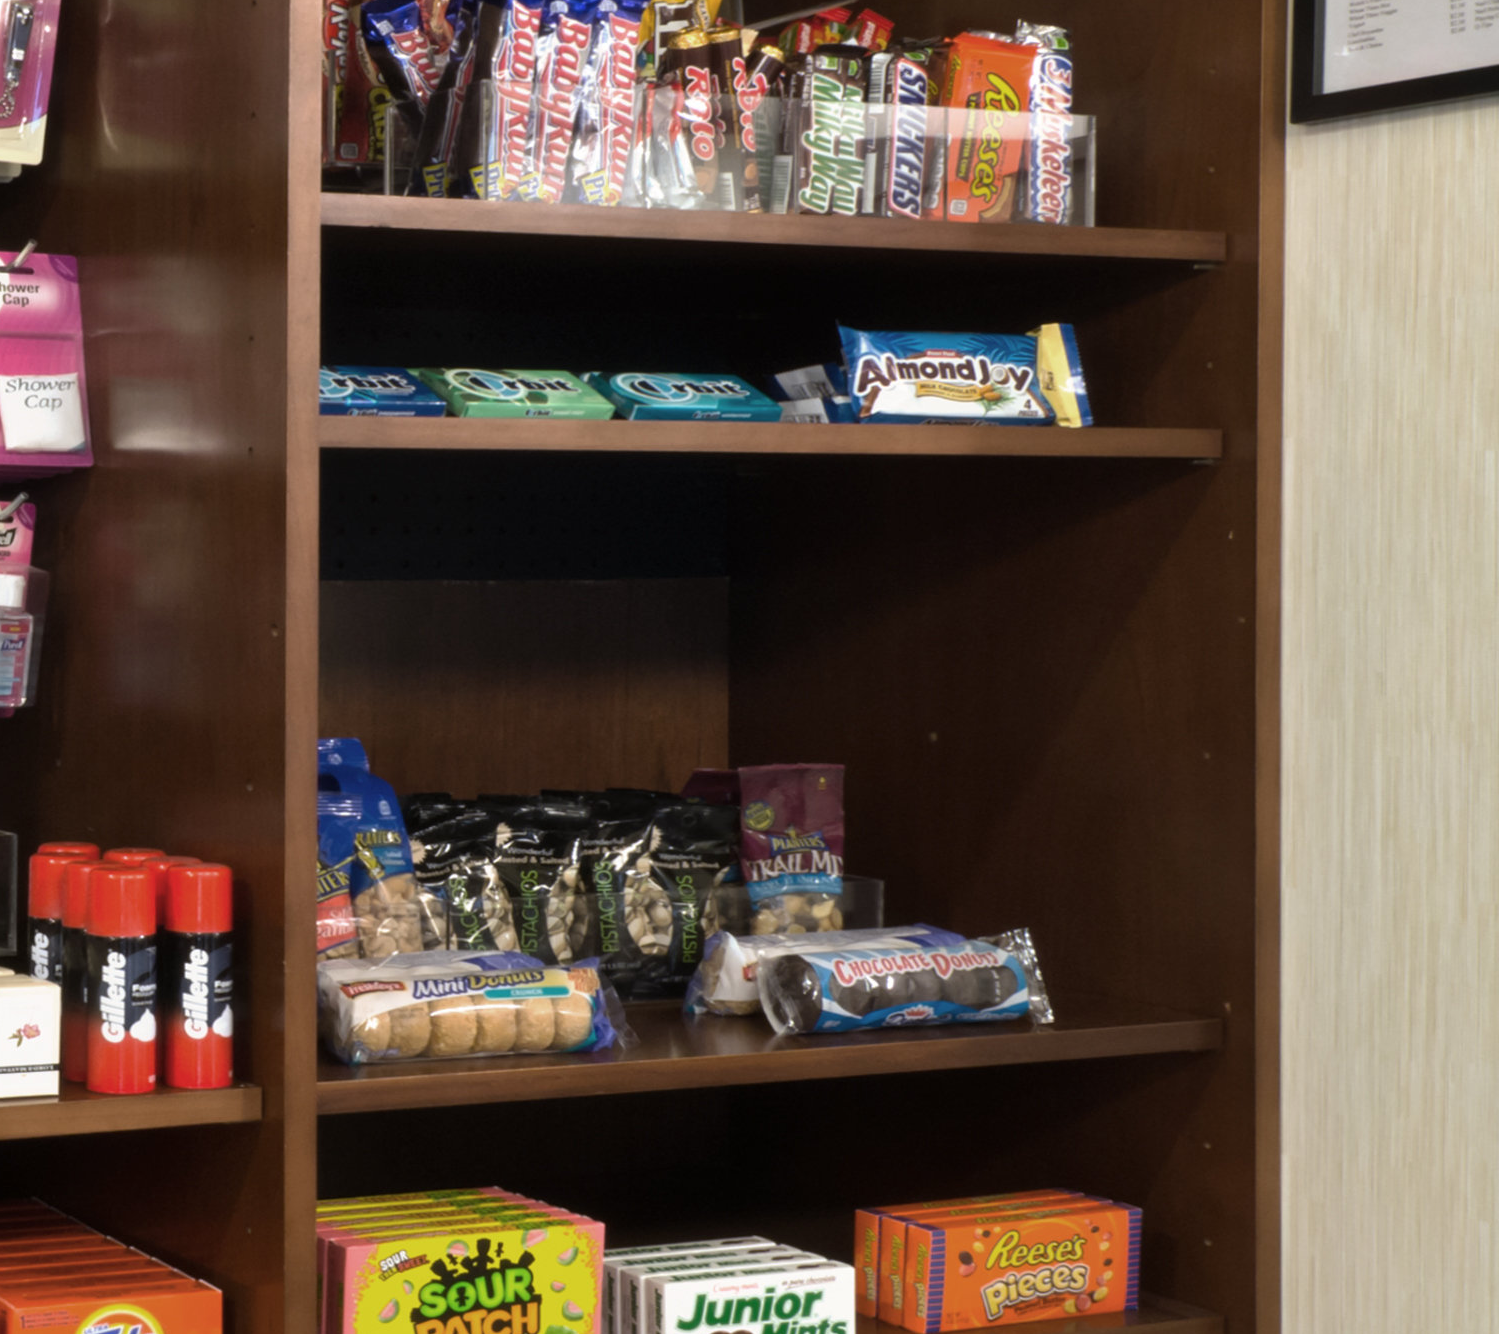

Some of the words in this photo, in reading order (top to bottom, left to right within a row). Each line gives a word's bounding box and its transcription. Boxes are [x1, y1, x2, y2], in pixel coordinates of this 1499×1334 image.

[891, 60, 928, 218] SNICKERS
[1, 292, 31, 308] Cap
[4, 377, 77, 396] Shower
[856, 356, 977, 395] Almond
[23, 393, 64, 413] Cap
[412, 979, 466, 1000] Mini
[468, 970, 545, 992] Donuts
[833, 951, 931, 987] CHOCOLATE
[932, 949, 1000, 980] DONUTS
[99, 950, 127, 1044] Gillette
[419, 1267, 533, 1318] SOUR
[675, 1286, 825, 1332] Junior
